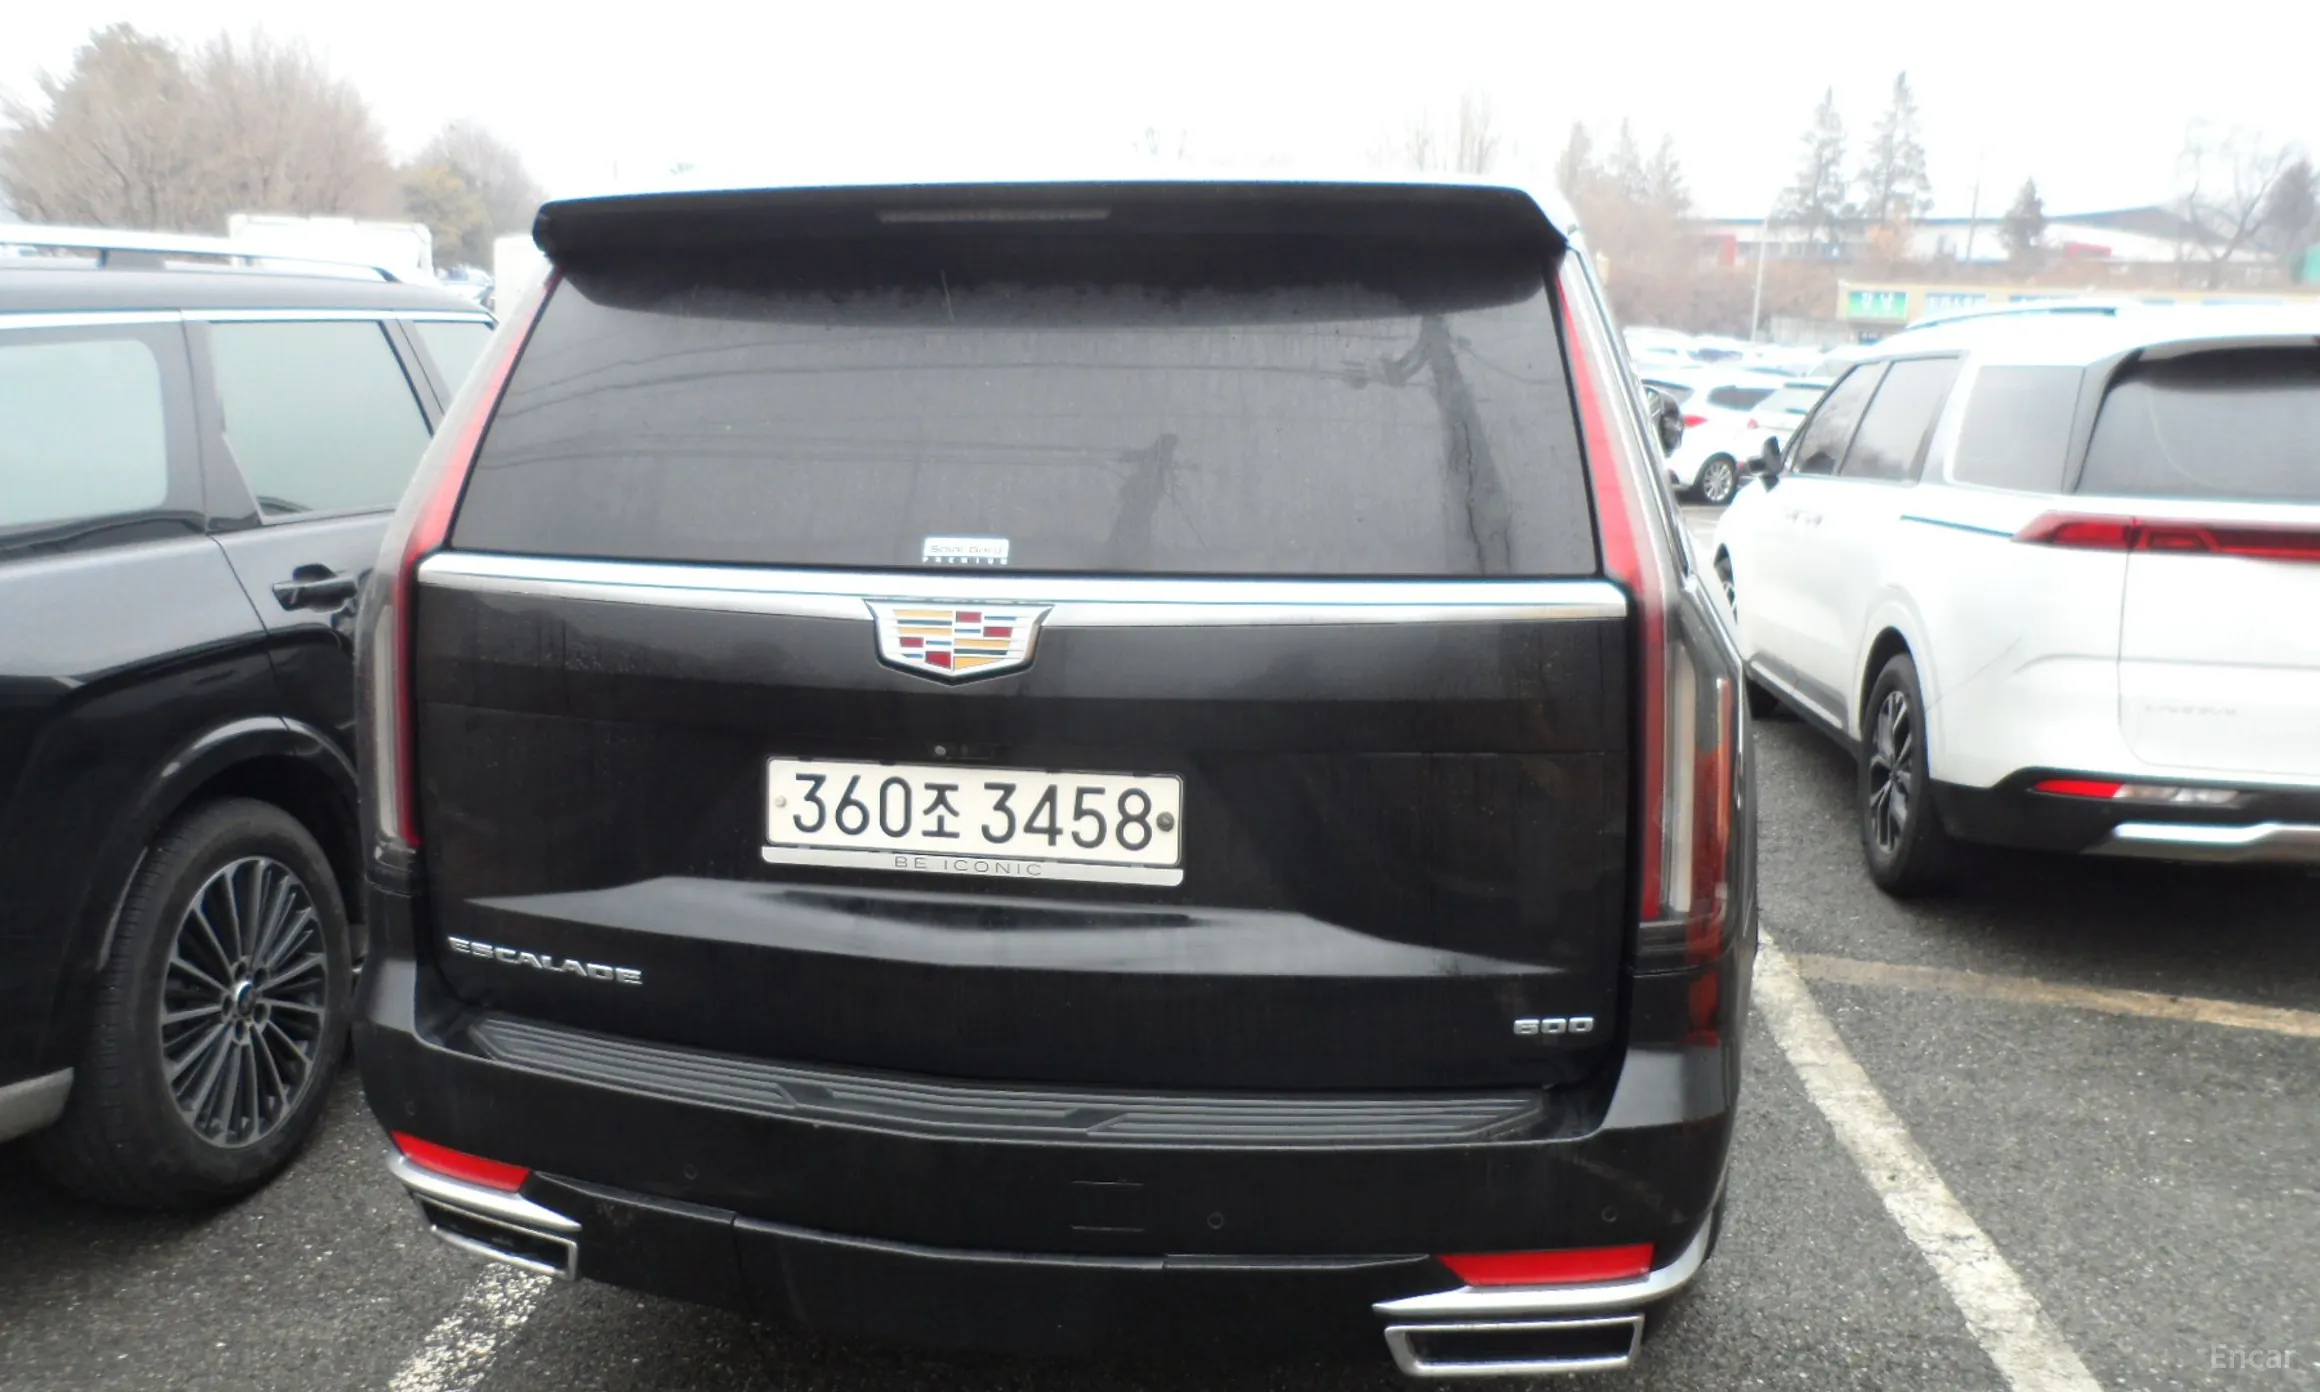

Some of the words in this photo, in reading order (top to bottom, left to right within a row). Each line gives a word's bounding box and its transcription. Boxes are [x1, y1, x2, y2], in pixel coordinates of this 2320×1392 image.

[793, 773, 961, 839] 360조
[981, 782, 1153, 851] 3458
[894, 855, 928, 869] BE
[944, 859, 1042, 877] ICONIC
[448, 936, 644, 985] ESCALADE
[1513, 1016, 1595, 1035] 600
